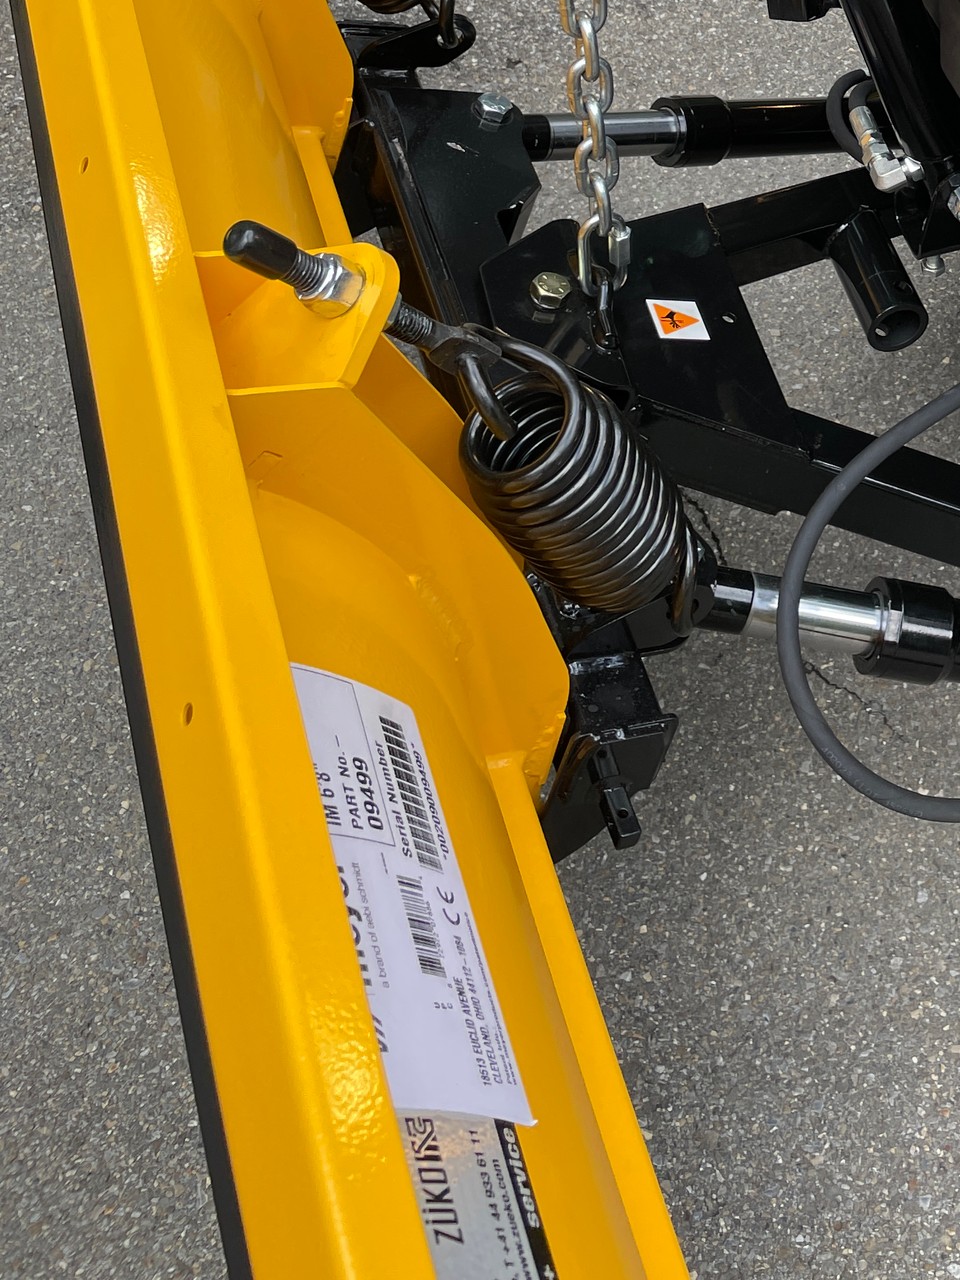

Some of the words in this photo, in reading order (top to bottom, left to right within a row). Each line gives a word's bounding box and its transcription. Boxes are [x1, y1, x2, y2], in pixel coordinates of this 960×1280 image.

[338, 751, 350, 778] No.
[375, 740, 398, 804] Number
[342, 783, 364, 830] PART
[352, 756, 384, 830] 09499
[391, 810, 412, 858] Serial
[352, 862, 368, 904] schmidt
[363, 907, 375, 929] aebi
[368, 932, 378, 942] of
[371, 945, 387, 978] brand
[453, 977, 473, 1017] AVENUE
[471, 996, 485, 1021] OHIO
[465, 1019, 483, 1055] EUCLID
[475, 1058, 491, 1086] 18513
[503, 1128, 540, 1228] service
